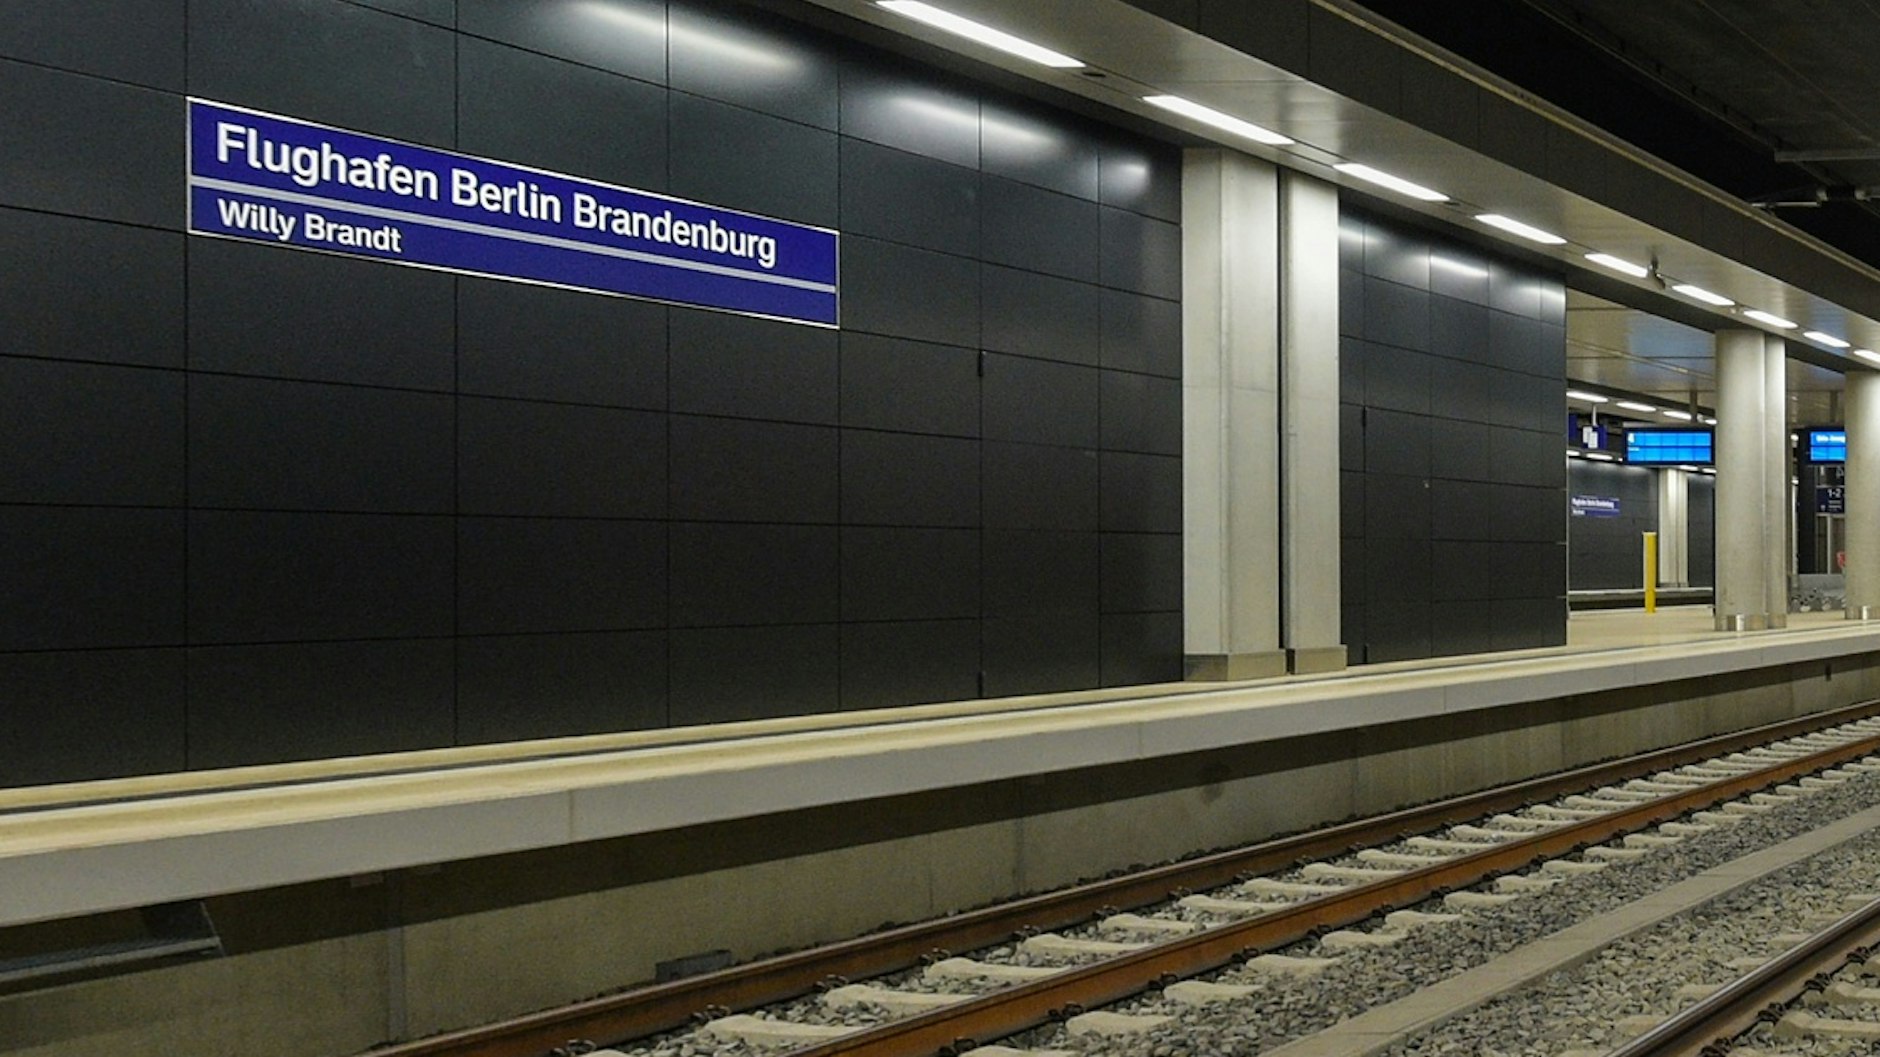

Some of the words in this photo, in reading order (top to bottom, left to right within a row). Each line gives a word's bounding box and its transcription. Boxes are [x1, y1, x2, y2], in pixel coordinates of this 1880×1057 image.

[217, 122, 439, 201] Flughafen
[451, 168, 562, 224] Berlin
[573, 192, 776, 269] Brandenburg
[217, 198, 296, 242] Willy
[304, 212, 402, 253] Brandt
